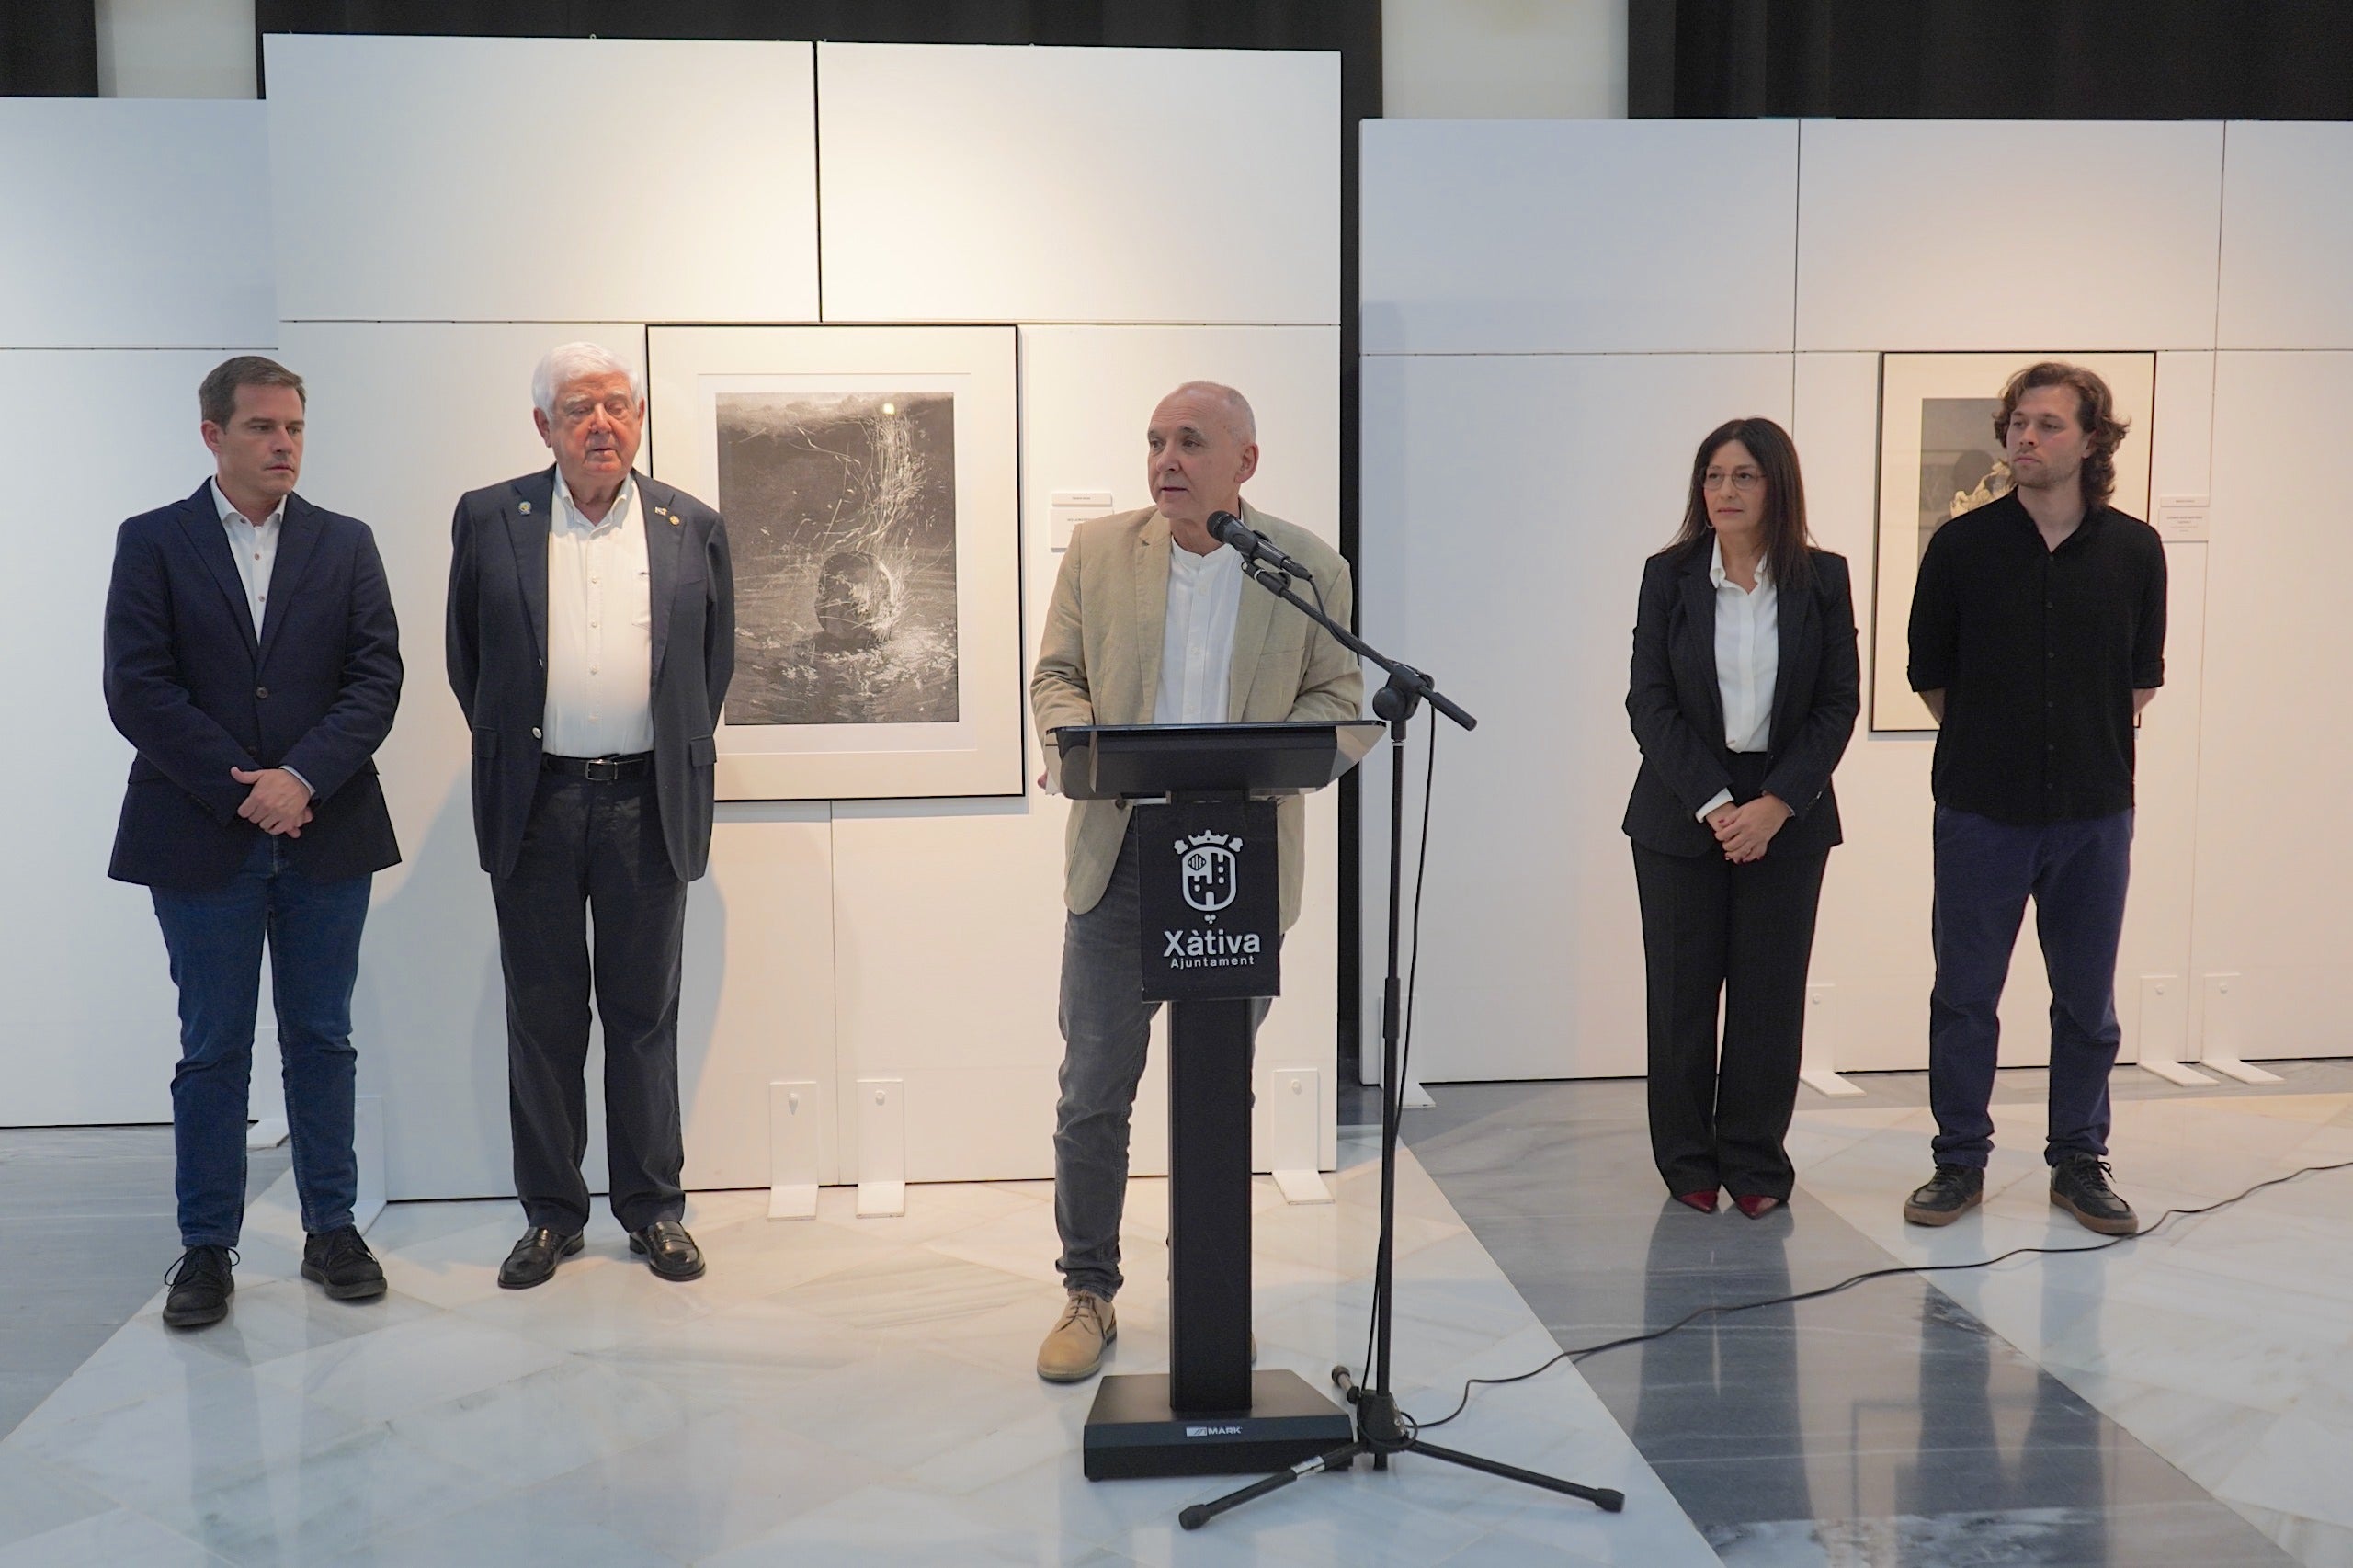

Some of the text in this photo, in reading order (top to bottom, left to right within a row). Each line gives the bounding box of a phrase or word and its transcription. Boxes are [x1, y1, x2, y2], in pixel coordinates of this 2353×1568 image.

[1163, 928, 1261, 957] Xàtiva
[1170, 956, 1255, 970] Ajuntament
[1208, 1426, 1242, 1436] MARK
